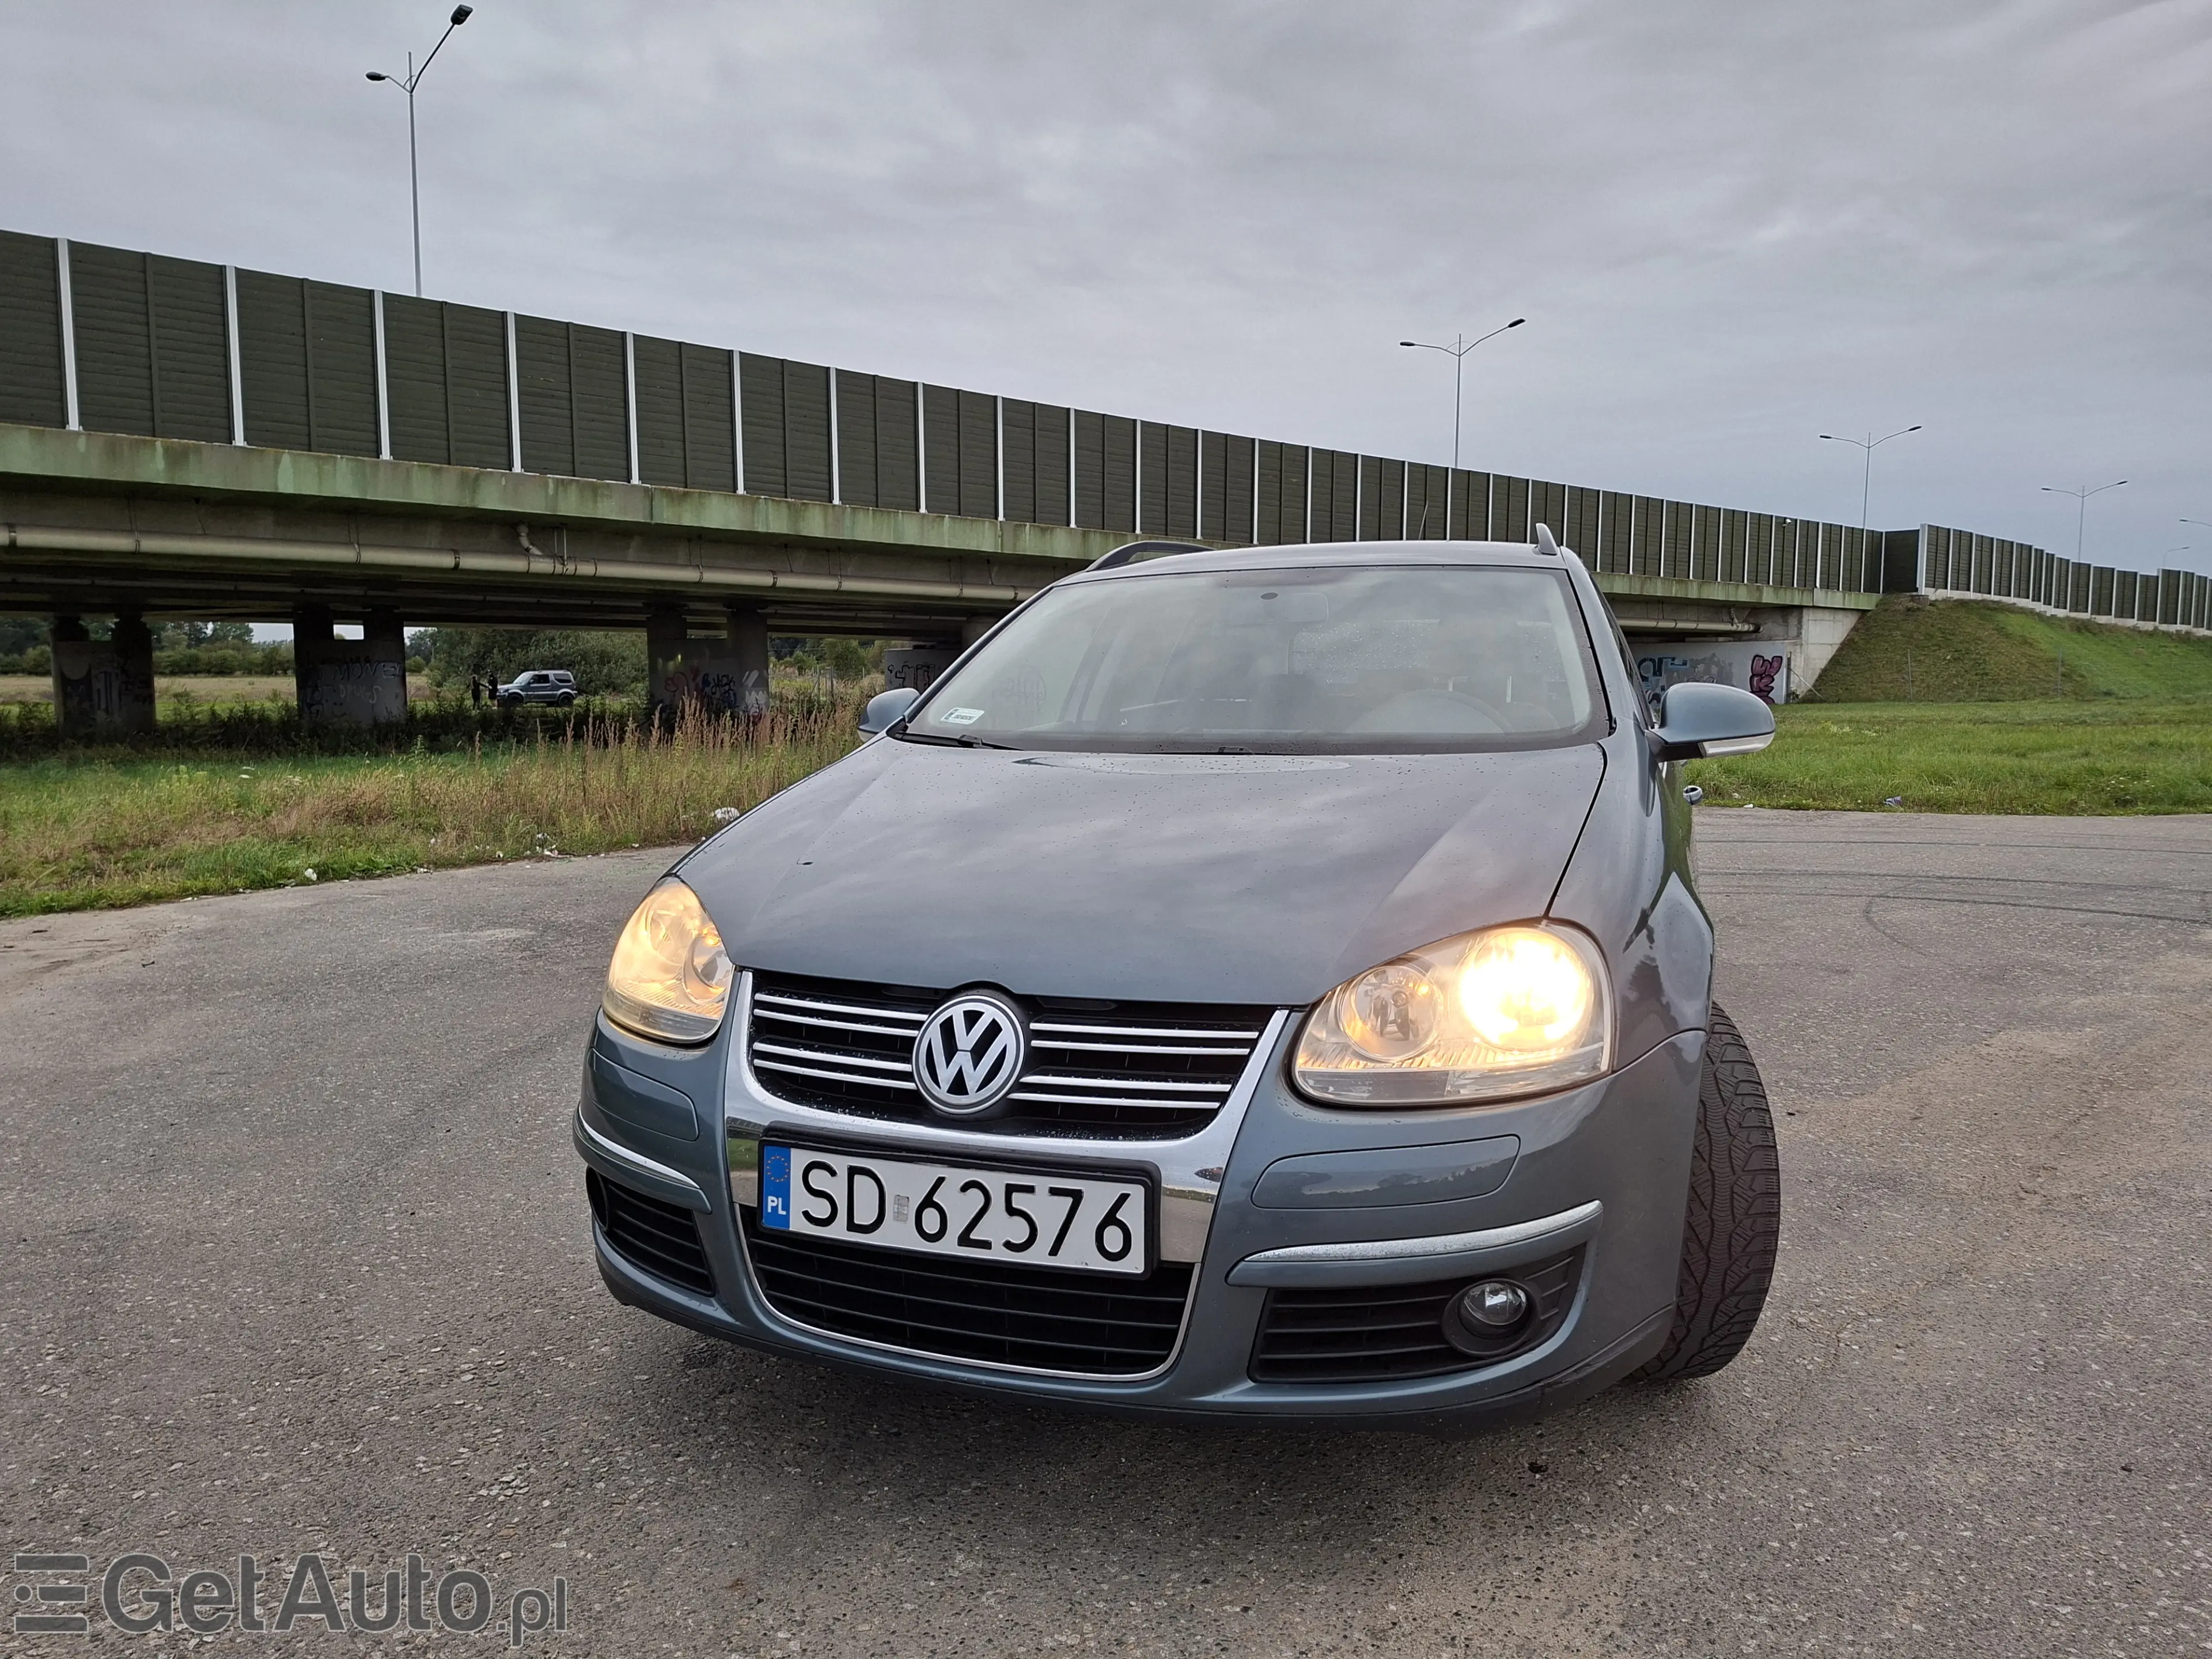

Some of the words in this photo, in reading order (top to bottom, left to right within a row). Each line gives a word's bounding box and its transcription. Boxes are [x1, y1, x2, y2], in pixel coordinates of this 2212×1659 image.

[767, 1195, 787, 1215] PL
[801, 1160, 887, 1234] SD
[914, 1176, 1133, 1262] 62576
